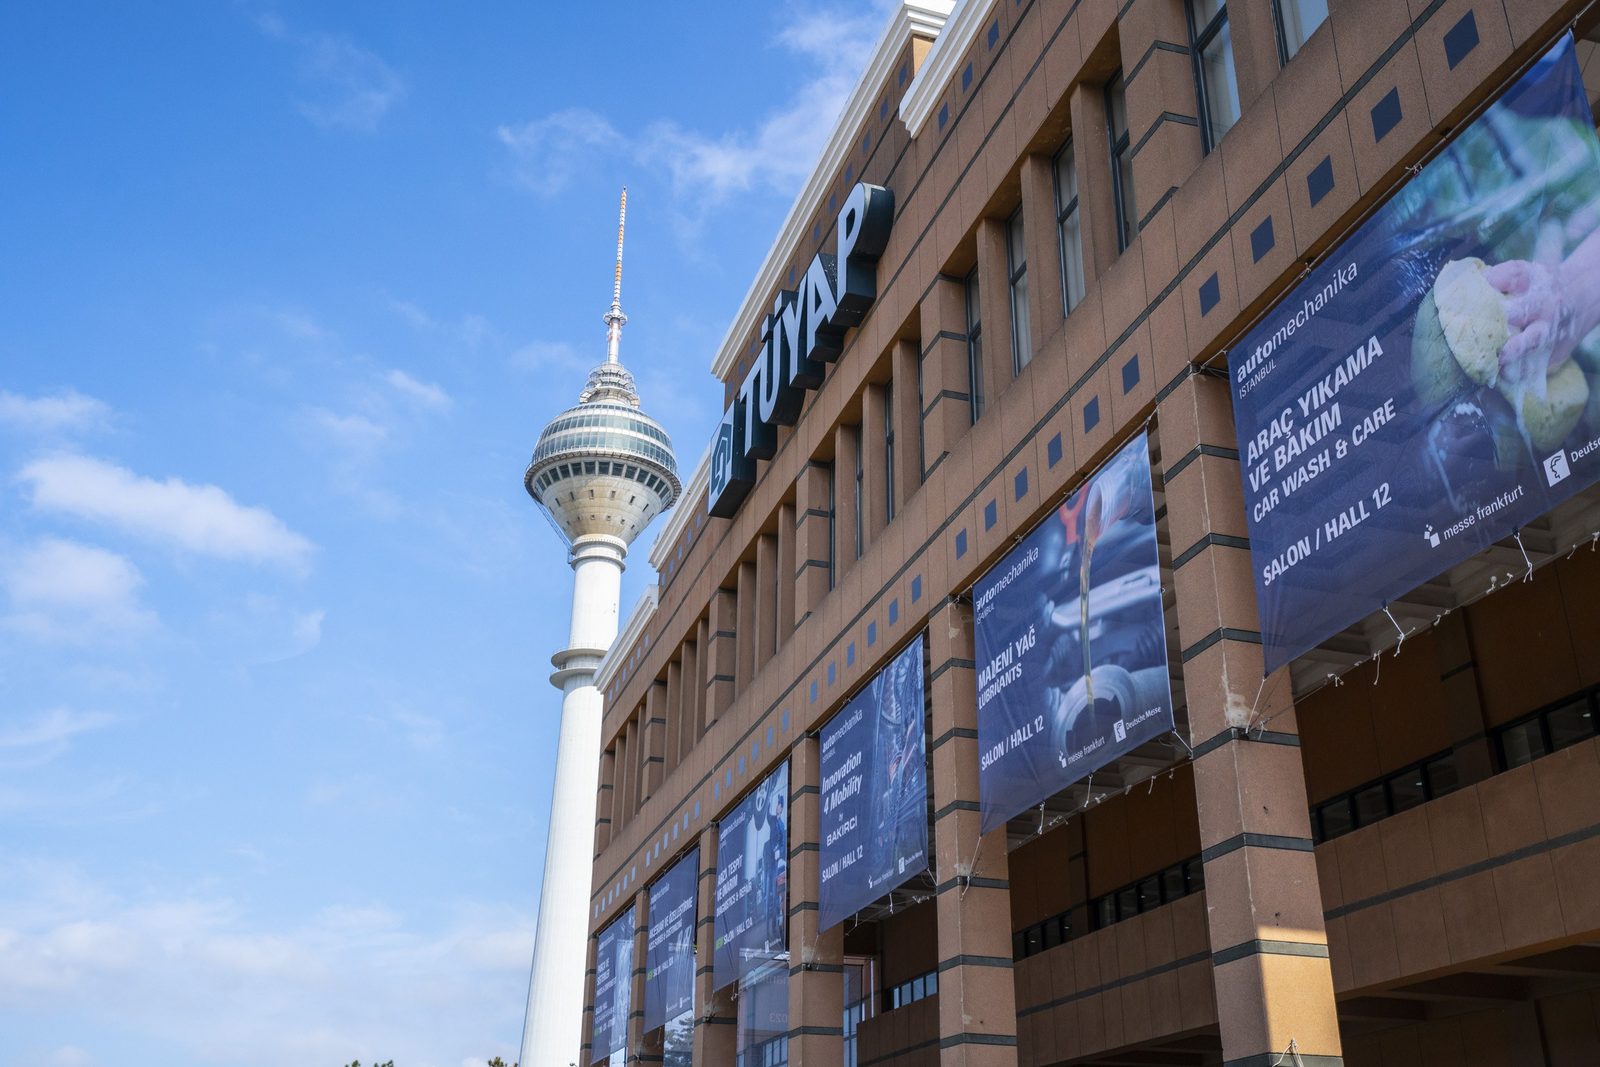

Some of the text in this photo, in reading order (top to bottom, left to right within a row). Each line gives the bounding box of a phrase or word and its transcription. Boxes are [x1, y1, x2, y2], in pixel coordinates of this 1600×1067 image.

[740, 181, 868, 457] TÜYAP
[1237, 262, 1358, 383] automechanika
[1239, 359, 1277, 399] ISTANBUL
[1247, 335, 1384, 467] ARAÇ YIKAMA
[1248, 402, 1342, 493] VE BAKIM
[1253, 397, 1397, 523] CAR WASH & CARE
[1263, 482, 1392, 586] SALON / HALL 12
[1443, 484, 1525, 541] messe frankfurt
[976, 547, 1039, 613] automechanika
[1015, 623, 1036, 658] YAĞ
[1145, 706, 1162, 718] Messe
[981, 715, 1044, 771] SALON / HALL 12
[1067, 750, 1084, 765] messe
[822, 751, 862, 795] Innovation
[824, 774, 863, 815] 4 Mobility
[822, 860, 839, 883] SALON
[842, 850, 857, 869] HALL
[857, 845, 863, 860] 12
